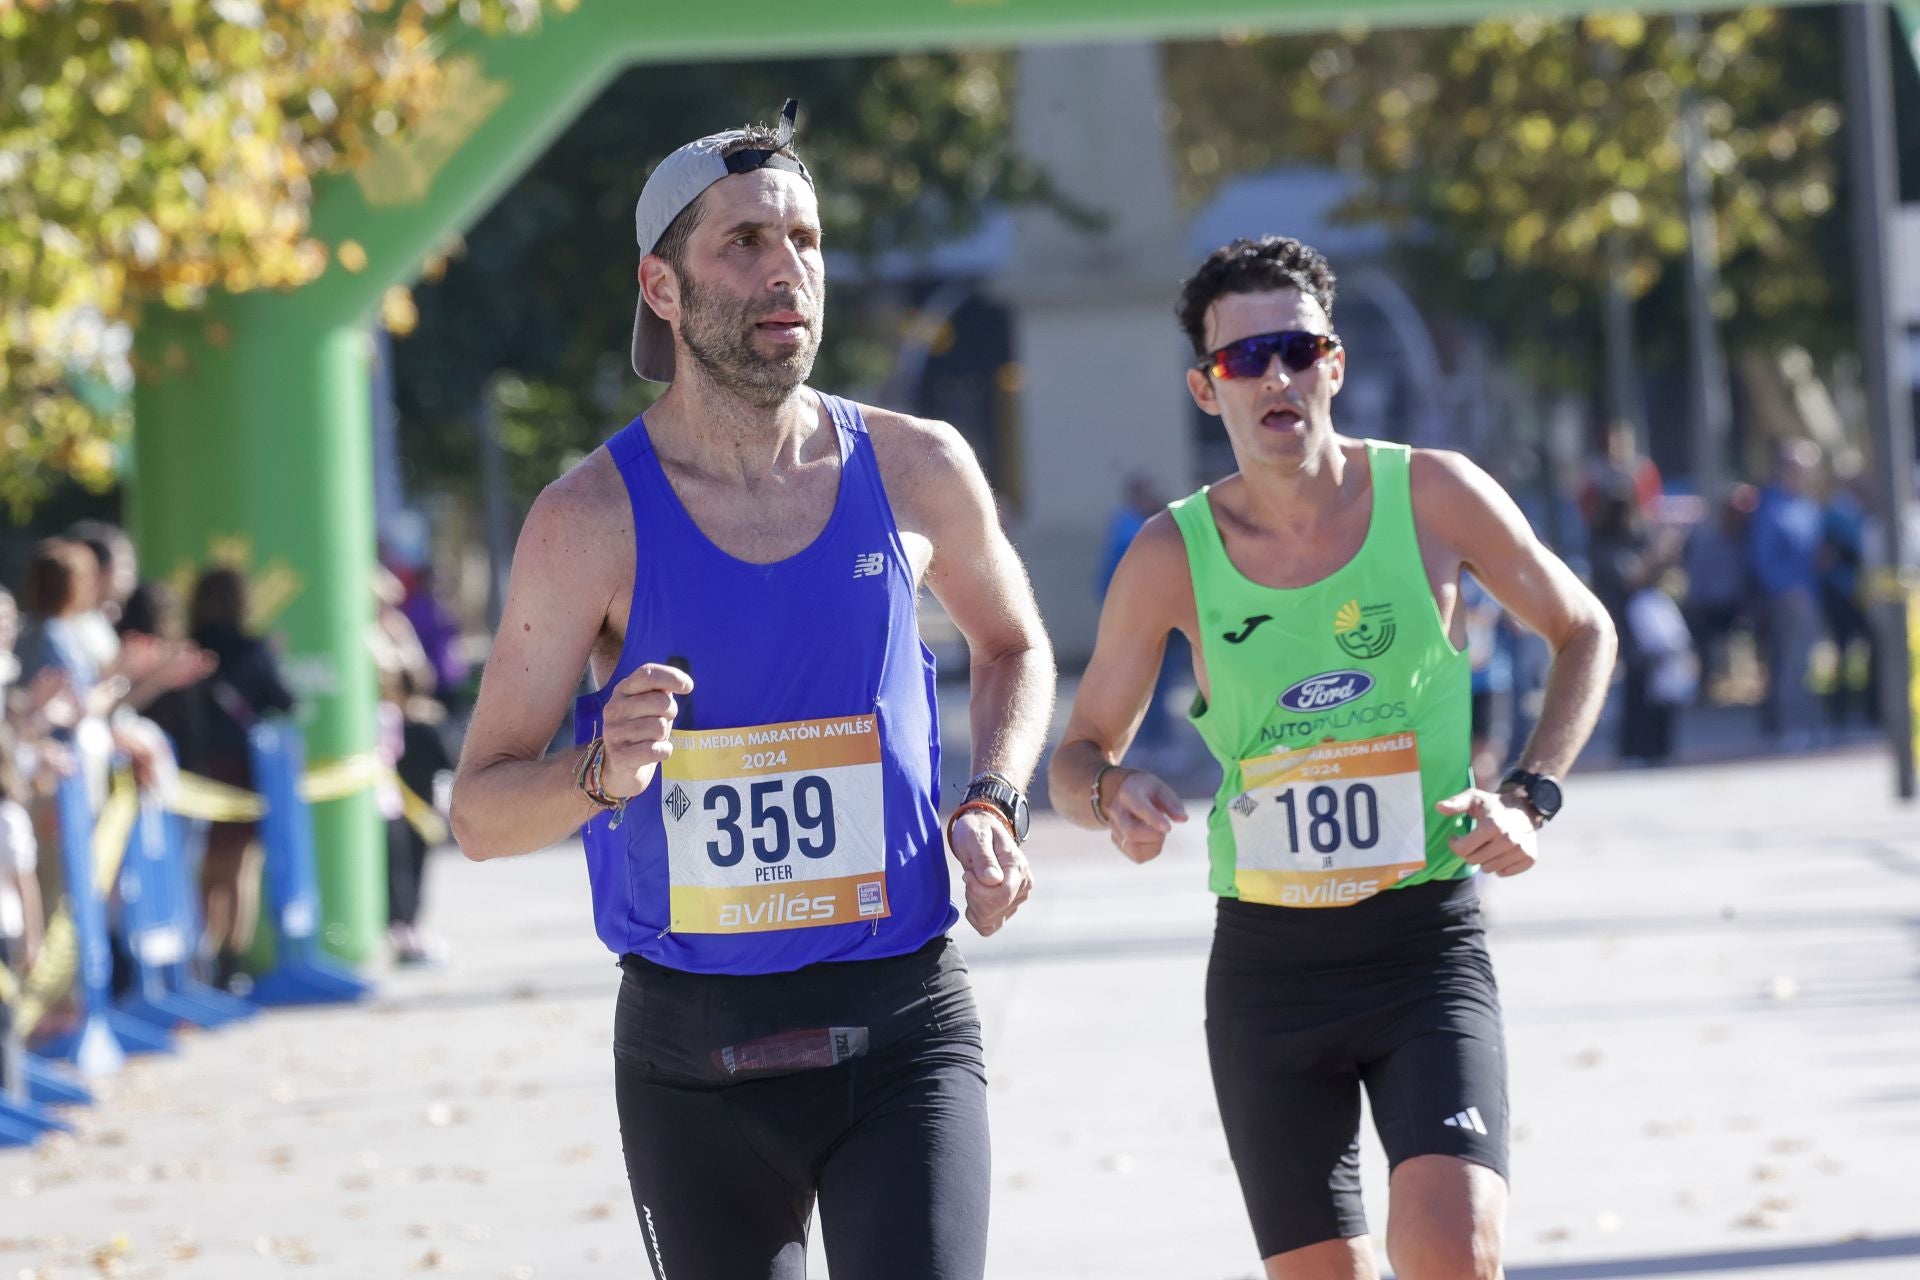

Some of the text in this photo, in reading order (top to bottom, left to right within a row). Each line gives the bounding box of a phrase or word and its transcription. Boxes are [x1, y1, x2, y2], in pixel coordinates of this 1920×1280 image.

[1297, 676, 1356, 708] Ford
[699, 733, 745, 750] MEDIA
[748, 723, 820, 746] MARATÓN
[823, 717, 873, 738] AVILÉS
[1260, 701, 1407, 742] AUTOPALACIOS
[741, 750, 788, 769] 2024
[1372, 735, 1414, 753] AVILÉS
[1301, 763, 1341, 777] 2024
[703, 775, 836, 867] 359
[1275, 783, 1379, 854] 180
[755, 864, 793, 882] PETER
[1281, 877, 1380, 904] avilés
[719, 892, 836, 927] avilés
